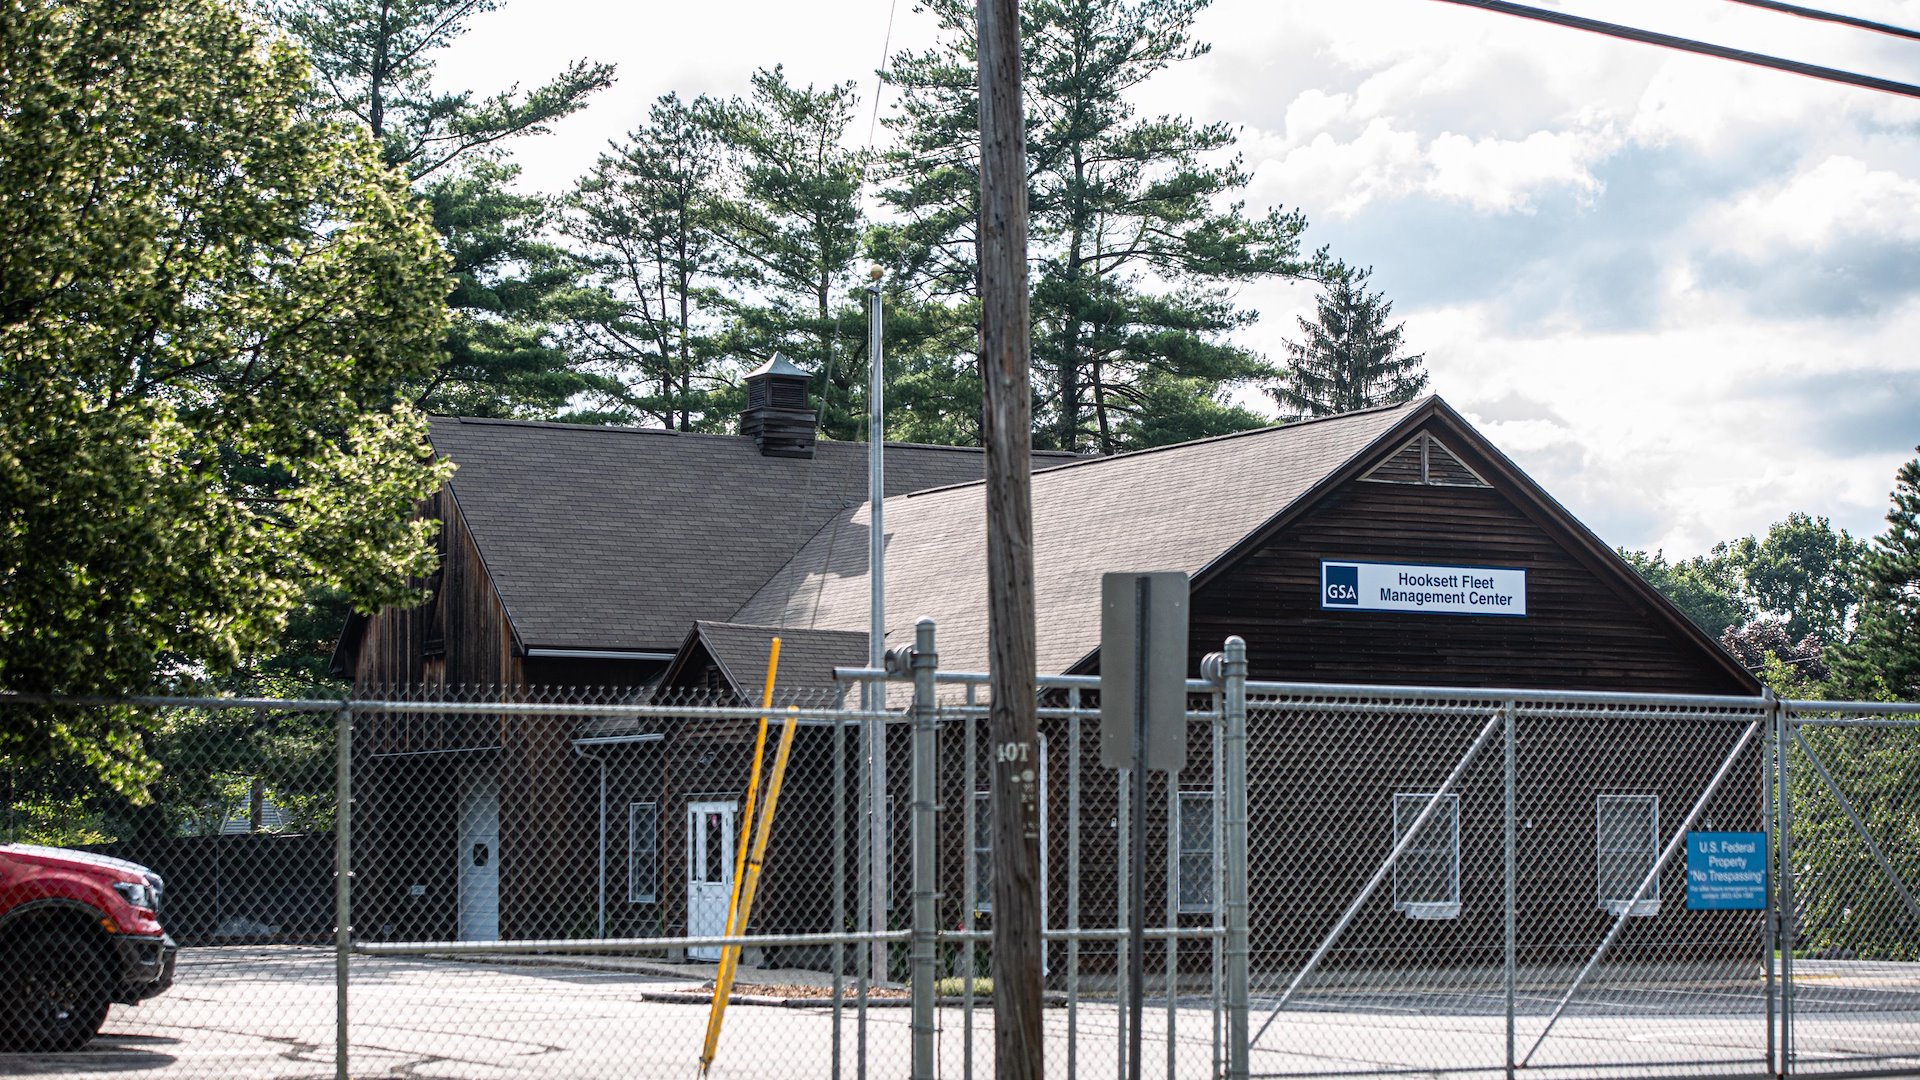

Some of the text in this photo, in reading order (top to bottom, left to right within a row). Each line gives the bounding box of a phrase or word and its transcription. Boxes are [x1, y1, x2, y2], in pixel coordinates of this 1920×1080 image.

[1399, 572, 1494, 589] Hooksett Fleet
[1327, 584, 1357, 599] GSA
[1380, 588, 1513, 606] Management Center
[1699, 841, 1756, 853] U.S. Federal
[1708, 855, 1747, 870] Property
